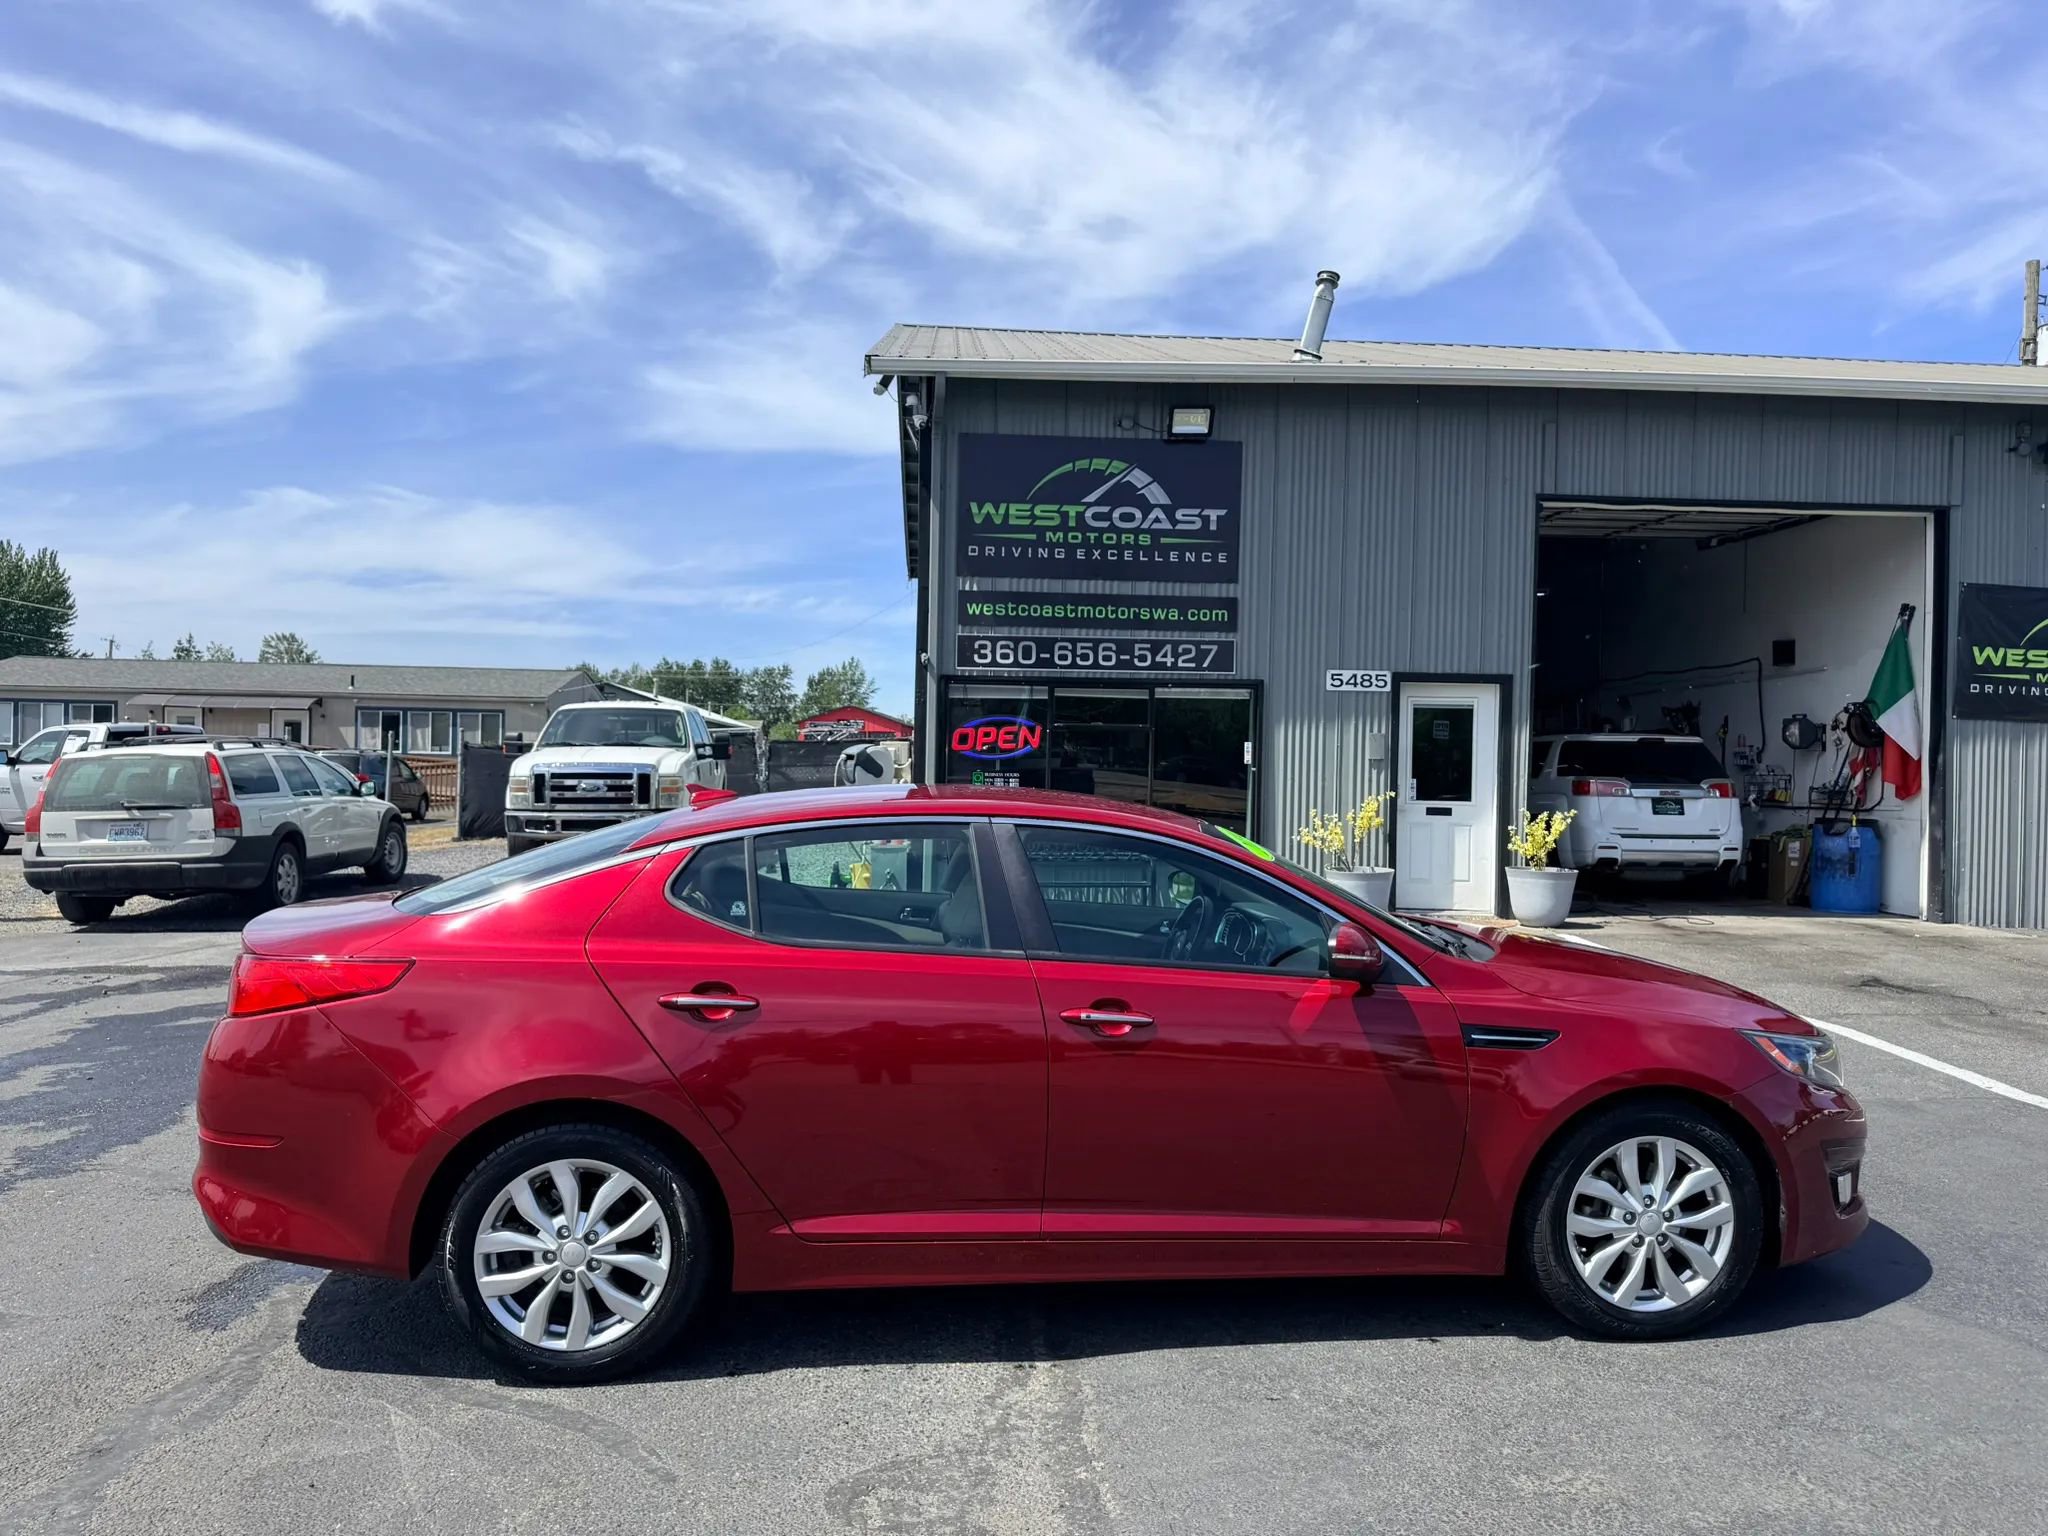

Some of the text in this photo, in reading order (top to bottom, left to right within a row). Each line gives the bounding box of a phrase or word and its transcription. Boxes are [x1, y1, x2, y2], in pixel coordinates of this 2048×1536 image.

[969, 502, 1228, 531] WESTCOAST
[1046, 531, 1151, 546] MOTORS
[968, 545, 1227, 563] DRIVING EXCELLENCE
[966, 602, 1228, 622] westcoastmotorswa.com
[973, 640, 1218, 668] 360-656-5427
[1330, 673, 1388, 688] 5485
[951, 725, 1042, 751] OPEN
